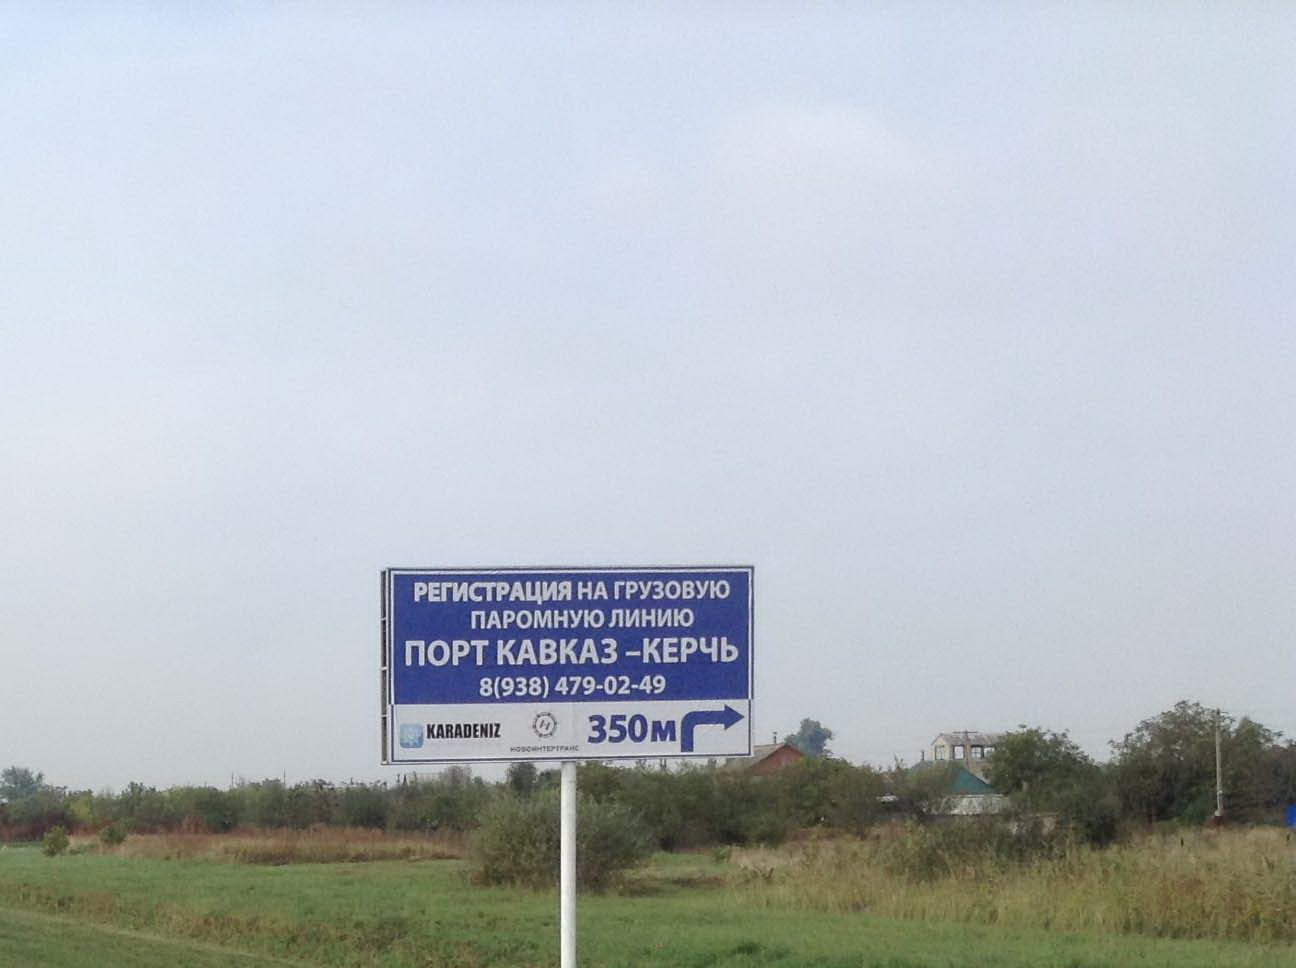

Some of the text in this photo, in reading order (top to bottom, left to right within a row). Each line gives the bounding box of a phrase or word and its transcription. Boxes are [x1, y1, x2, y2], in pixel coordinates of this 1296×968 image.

[413, 580, 731, 605] РЕГИСТРАЦИЯ НА ГРУЗОВУЮ
[470, 608, 695, 629] ПАРОМНУЮ ЛИНИЮ
[404, 639, 489, 666] ПОРТ
[496, 638, 618, 666] КАВКАЗ
[479, 675, 667, 699] 8(938) 479-02-49
[426, 722, 502, 740] KARADENIZ
